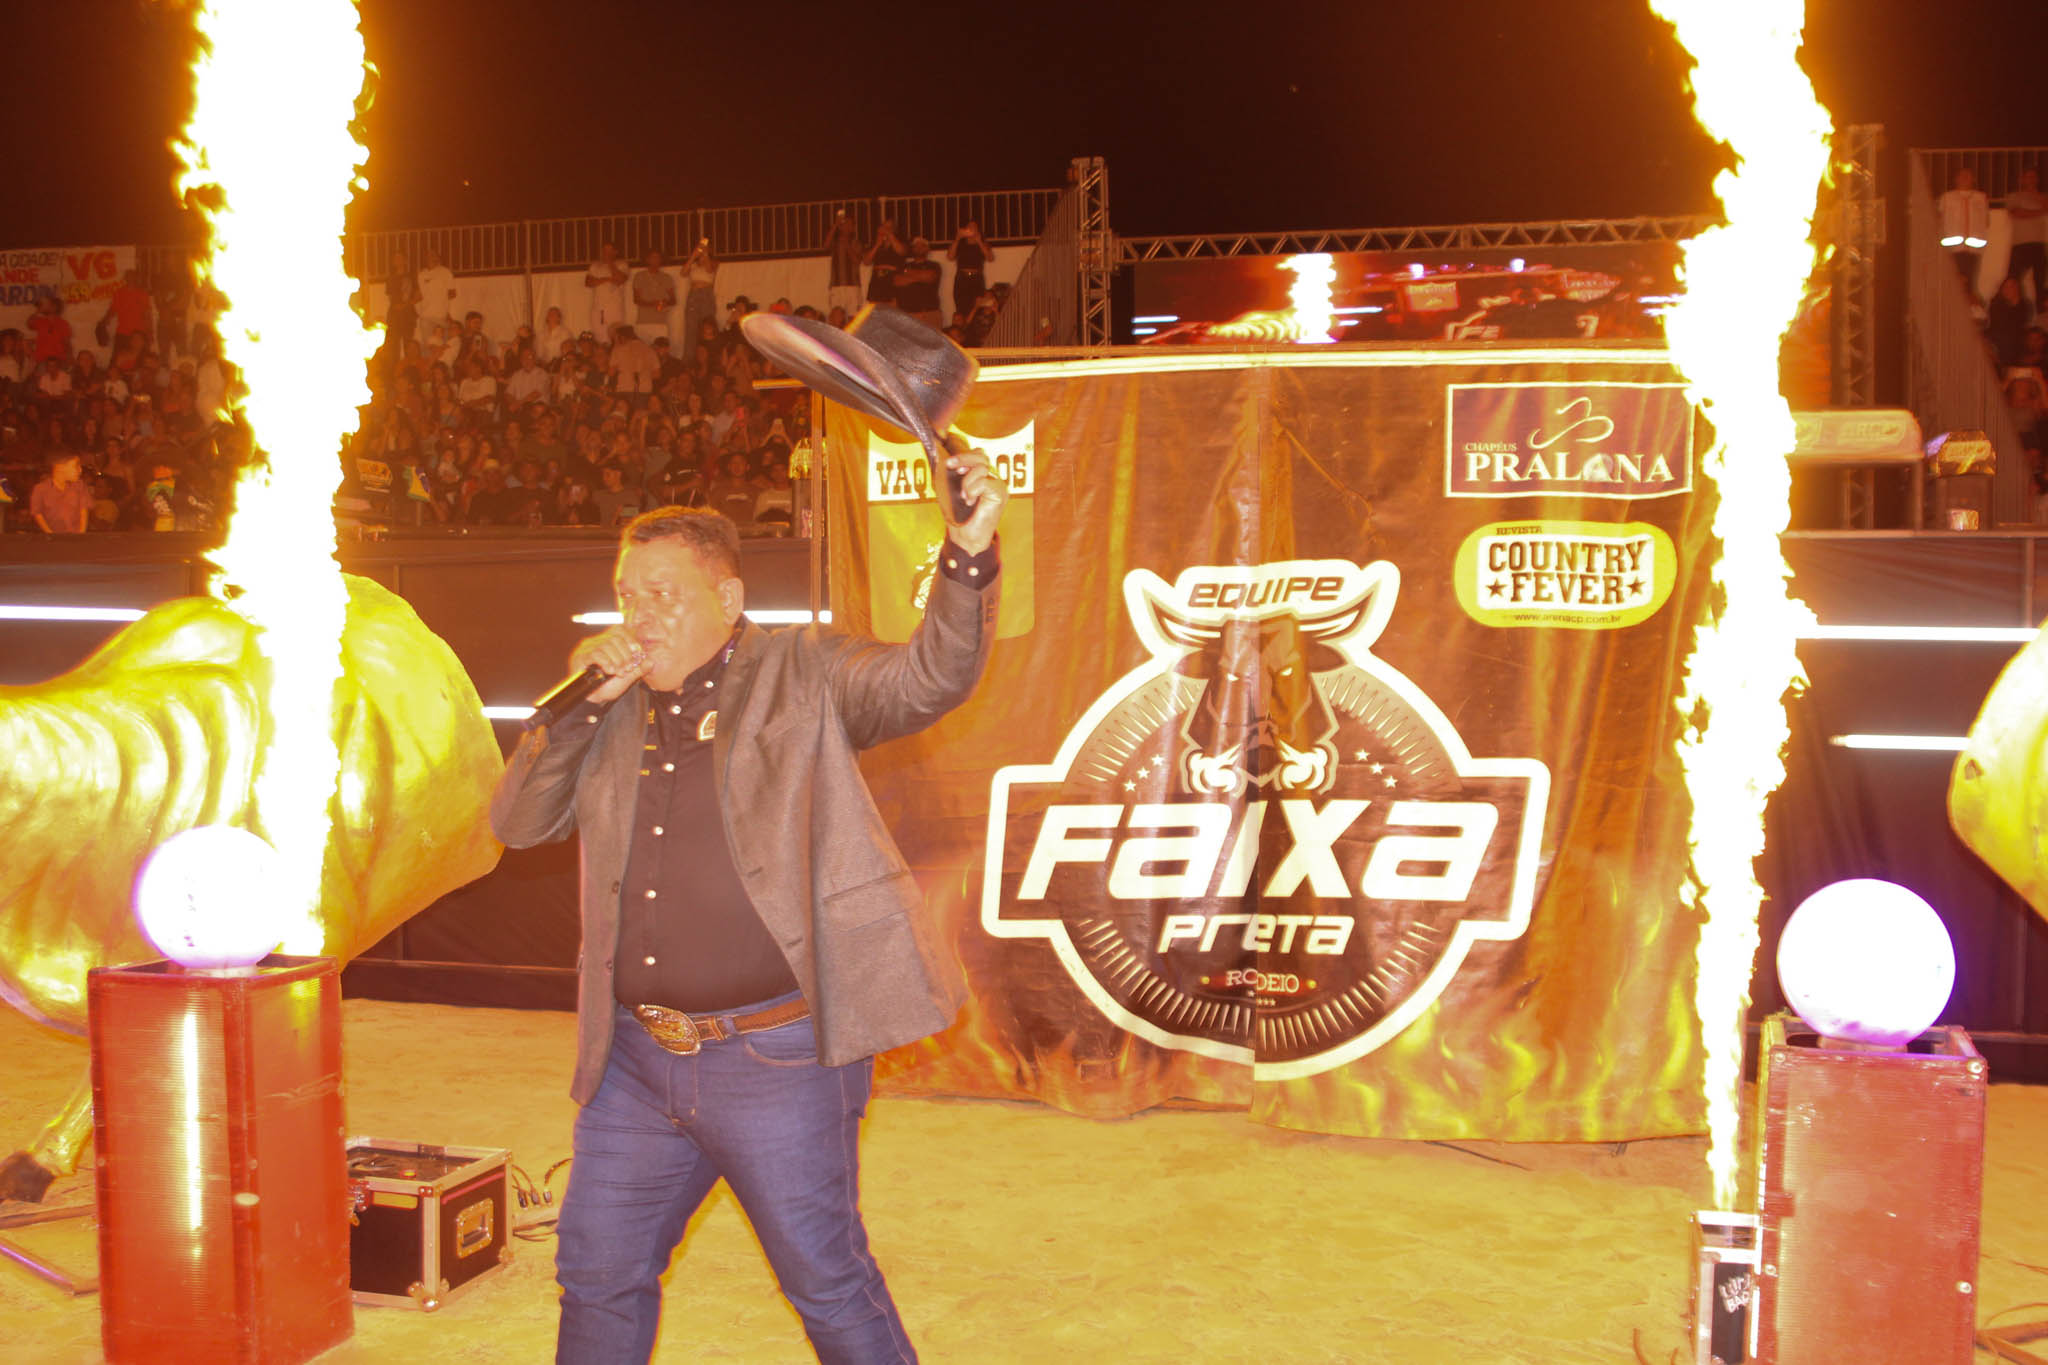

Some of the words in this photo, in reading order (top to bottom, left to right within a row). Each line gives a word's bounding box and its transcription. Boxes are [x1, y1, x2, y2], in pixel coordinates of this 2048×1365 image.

[1464, 441, 1517, 452] CHAPÉUS
[1465, 452, 1675, 483] PRALANA
[1496, 526, 1543, 536] REVISTA
[1488, 540, 1648, 574] COUNTRY
[1510, 572, 1626, 605] FEVER
[1225, 968, 1300, 993] RODEIO
